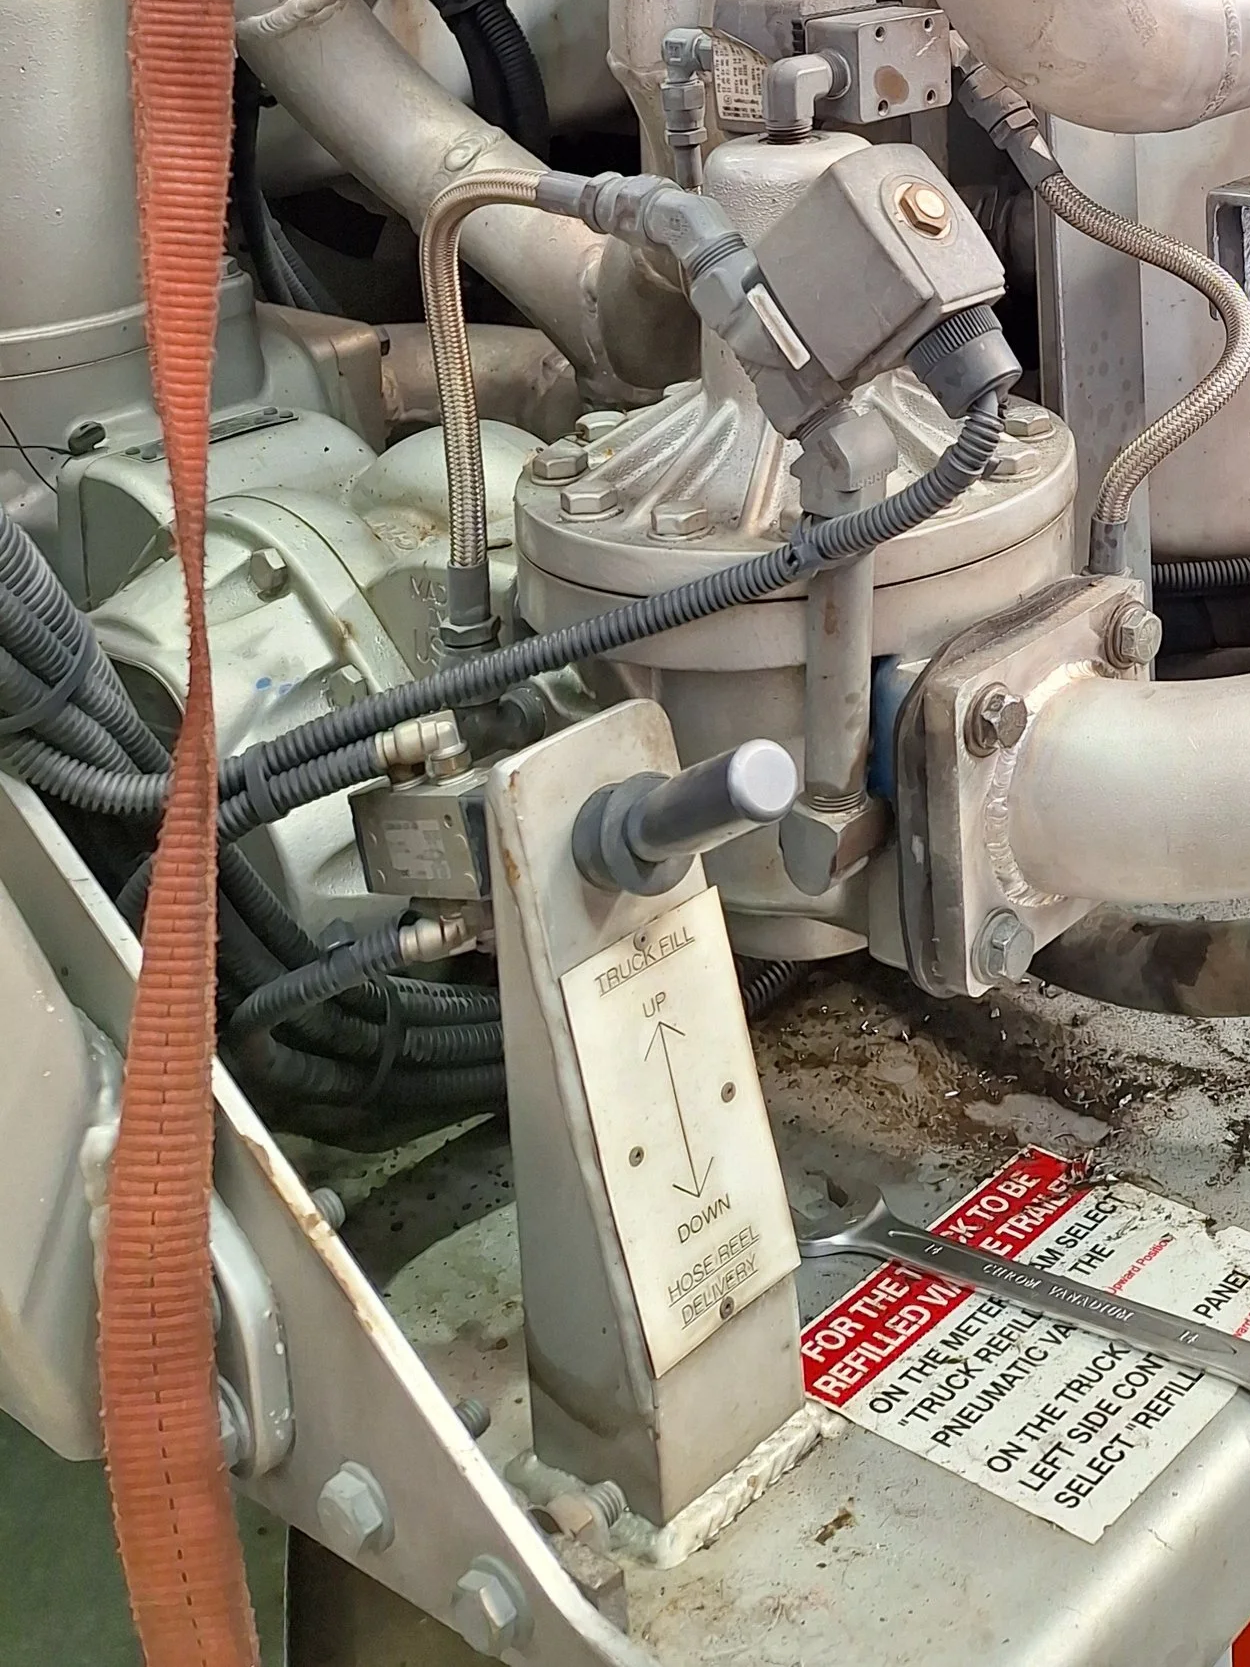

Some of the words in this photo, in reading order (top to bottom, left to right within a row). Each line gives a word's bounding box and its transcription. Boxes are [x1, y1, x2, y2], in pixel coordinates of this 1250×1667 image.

[594, 945, 657, 994] TRUCK
[658, 926, 695, 956] FILL
[642, 991, 667, 1018] UP
[677, 1193, 731, 1244] DOWN
[668, 1254, 715, 1303] HOSE
[717, 1225, 760, 1264] REEL
[681, 1253, 757, 1325] DELIVERY
[802, 1315, 866, 1364] FOR
[854, 1276, 910, 1320] THE
[966, 1195, 1008, 1223] TO
[1003, 1170, 1041, 1199] BE
[1068, 1244, 1116, 1276] THE
[869, 1384, 908, 1414] ON
[901, 1349, 950, 1385] THE
[1056, 1193, 1126, 1250] SELECT
[1048, 1285, 1135, 1321] VANADIUM
[813, 1304, 932, 1399] REFILLED
[930, 1345, 1048, 1448] PNEUMATIC
[987, 1441, 1028, 1473] ON
[1015, 1403, 1068, 1442] THE
[1054, 1342, 1131, 1403] TRUCK
[1018, 1441, 1075, 1492] LEFT
[1067, 1398, 1122, 1444] SIDE
[1054, 1433, 1136, 1509] SELECT
